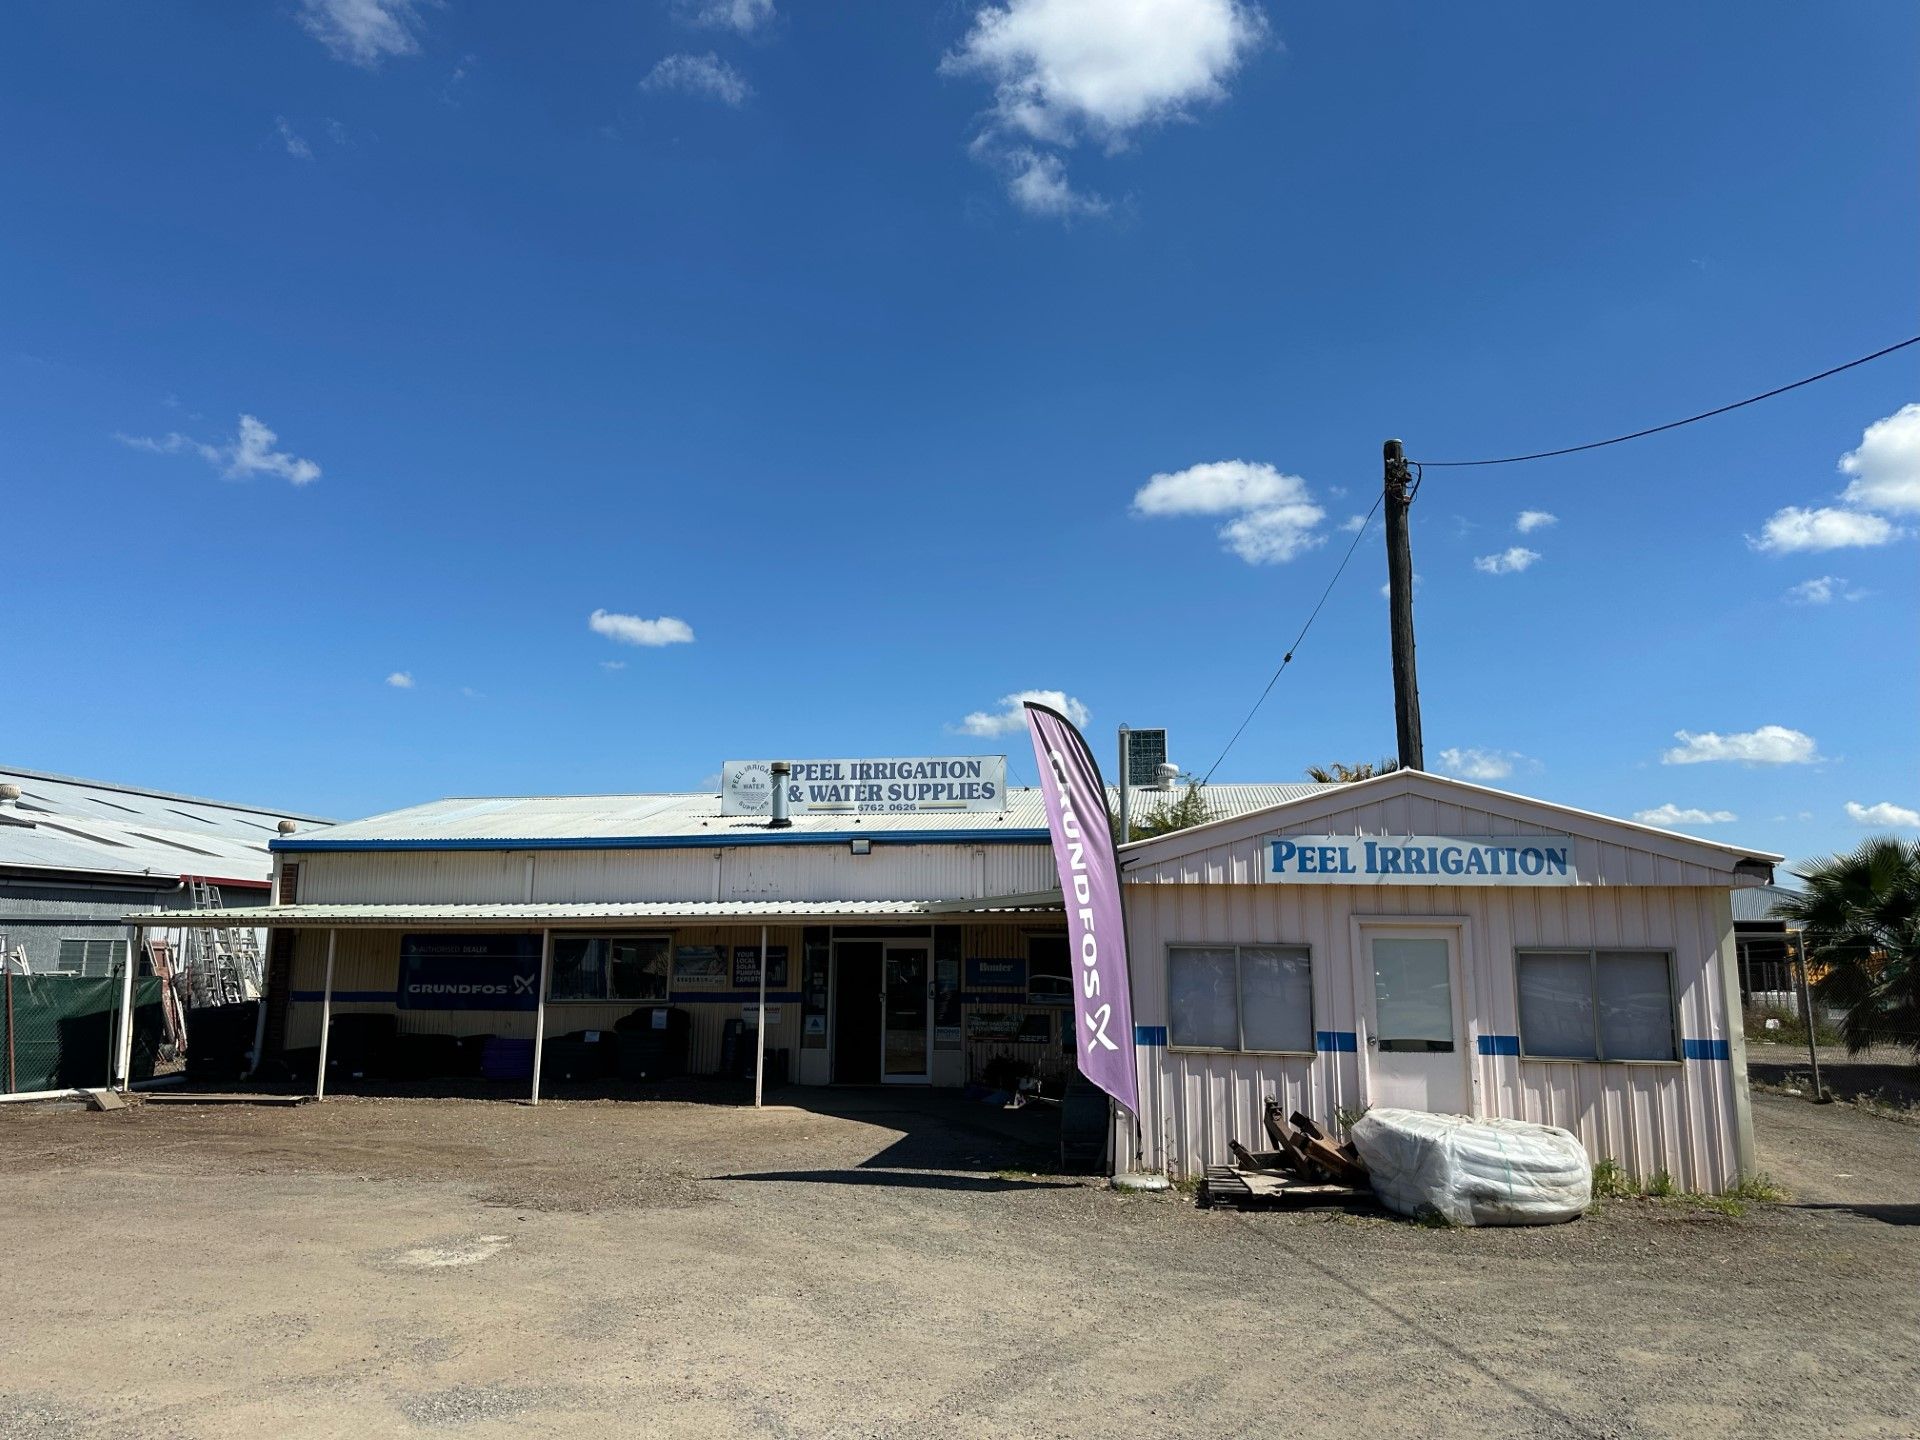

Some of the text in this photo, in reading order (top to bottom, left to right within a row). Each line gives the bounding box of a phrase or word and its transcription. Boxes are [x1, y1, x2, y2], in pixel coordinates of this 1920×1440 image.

[731, 771, 745, 788] PEEL
[791, 760, 982, 781] PEEL IRRIGATION
[788, 781, 996, 803] & WATER SUPPLIES
[857, 803, 917, 812] 6762 0626
[1271, 840, 1568, 876] PEEL IRRIGATION
[407, 983, 509, 995] GRUNDFOS
